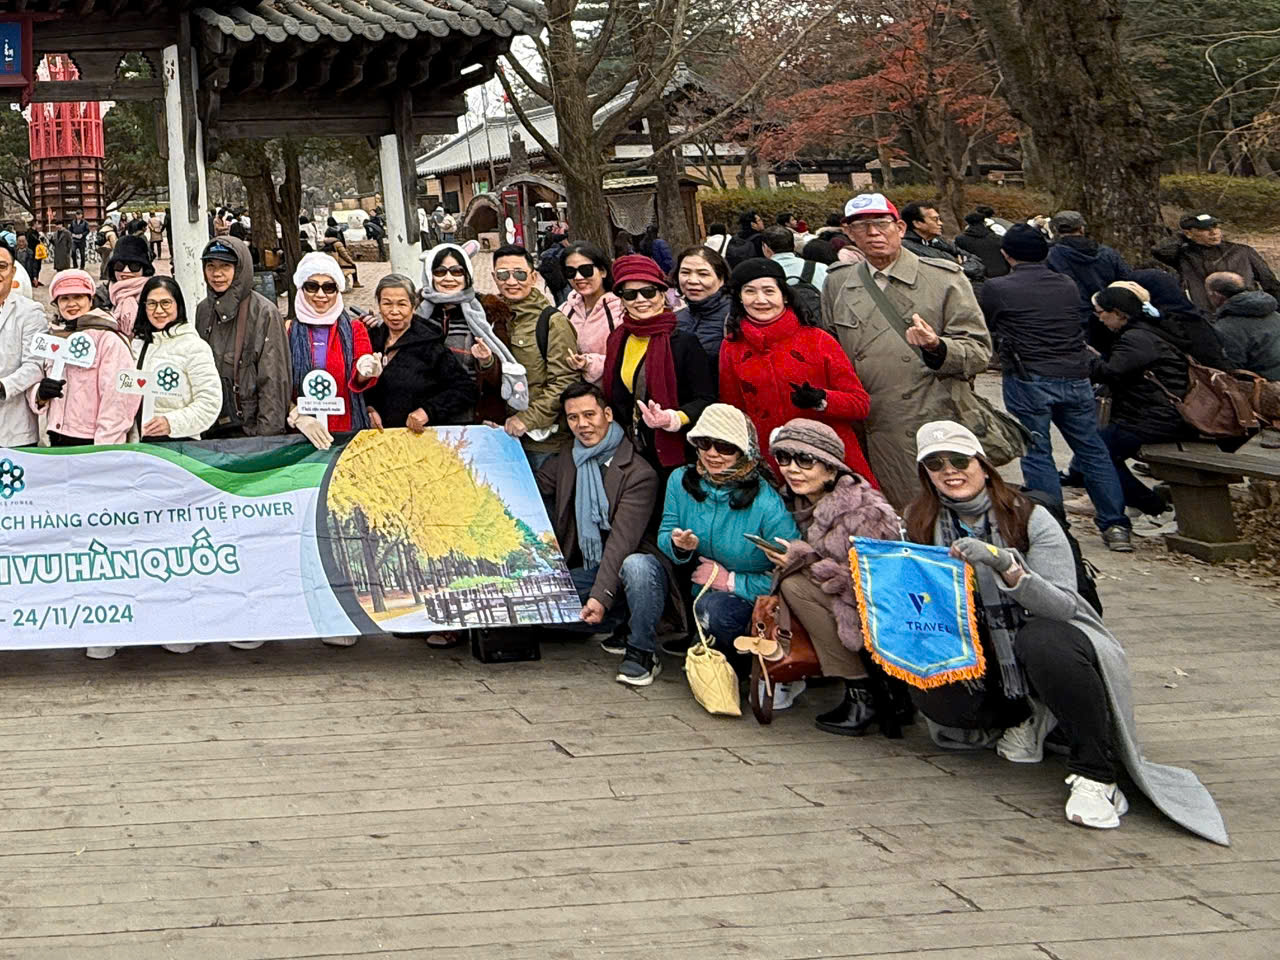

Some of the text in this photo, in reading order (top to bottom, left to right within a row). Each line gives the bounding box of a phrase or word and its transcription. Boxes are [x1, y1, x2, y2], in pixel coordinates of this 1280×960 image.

[31, 510, 82, 529] HÀNG
[87, 507, 140, 527] CÔNG
[143, 509, 164, 524] TY
[167, 504, 192, 523] TRÍ
[196, 502, 227, 523] TUỆ
[232, 501, 295, 519] POWER
[12, 552, 62, 584] VU
[65, 538, 140, 583] HÀN
[141, 526, 240, 583] QUỐC
[12, 604, 134, 630] 24/11/2024
[906, 621, 953, 635] TRAVEL
